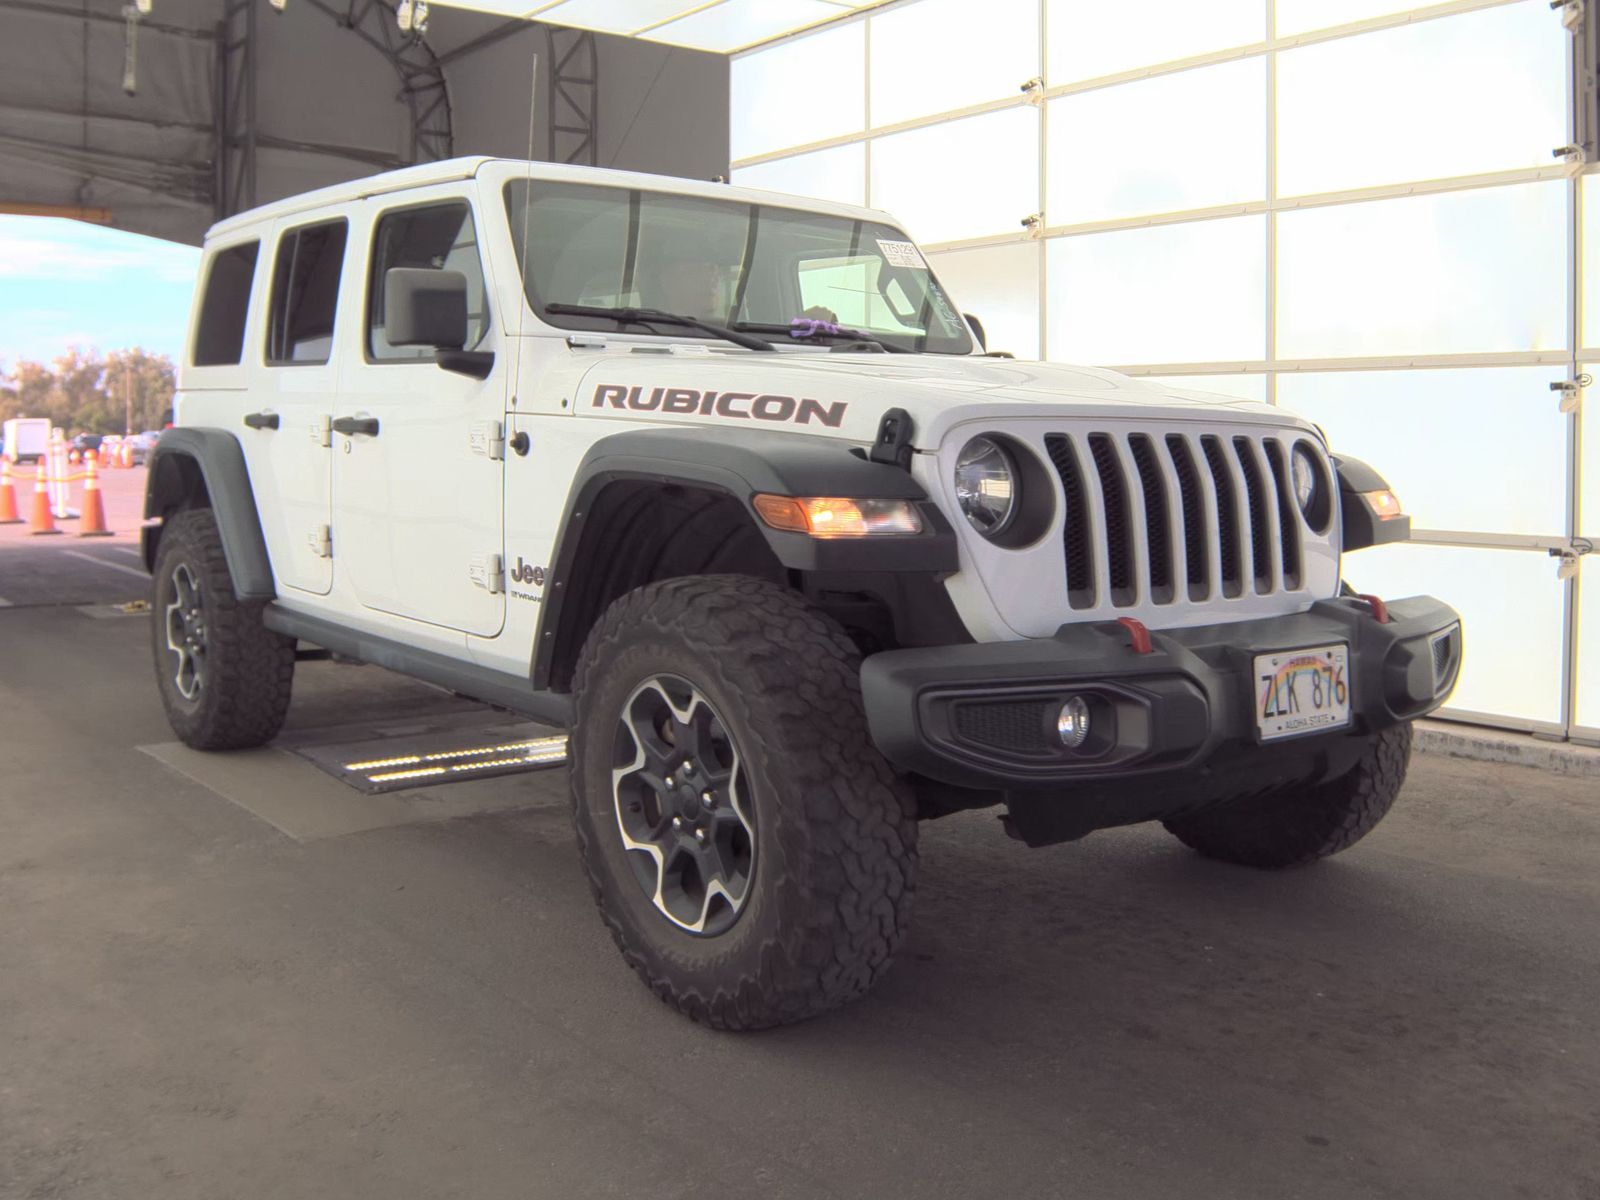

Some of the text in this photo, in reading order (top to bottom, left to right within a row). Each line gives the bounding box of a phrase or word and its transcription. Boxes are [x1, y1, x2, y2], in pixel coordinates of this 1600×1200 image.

[592, 384, 848, 427] RUBICON
[1261, 665, 1346, 718] ZLK 876
[1286, 714, 1329, 729] ALOHA STATE
